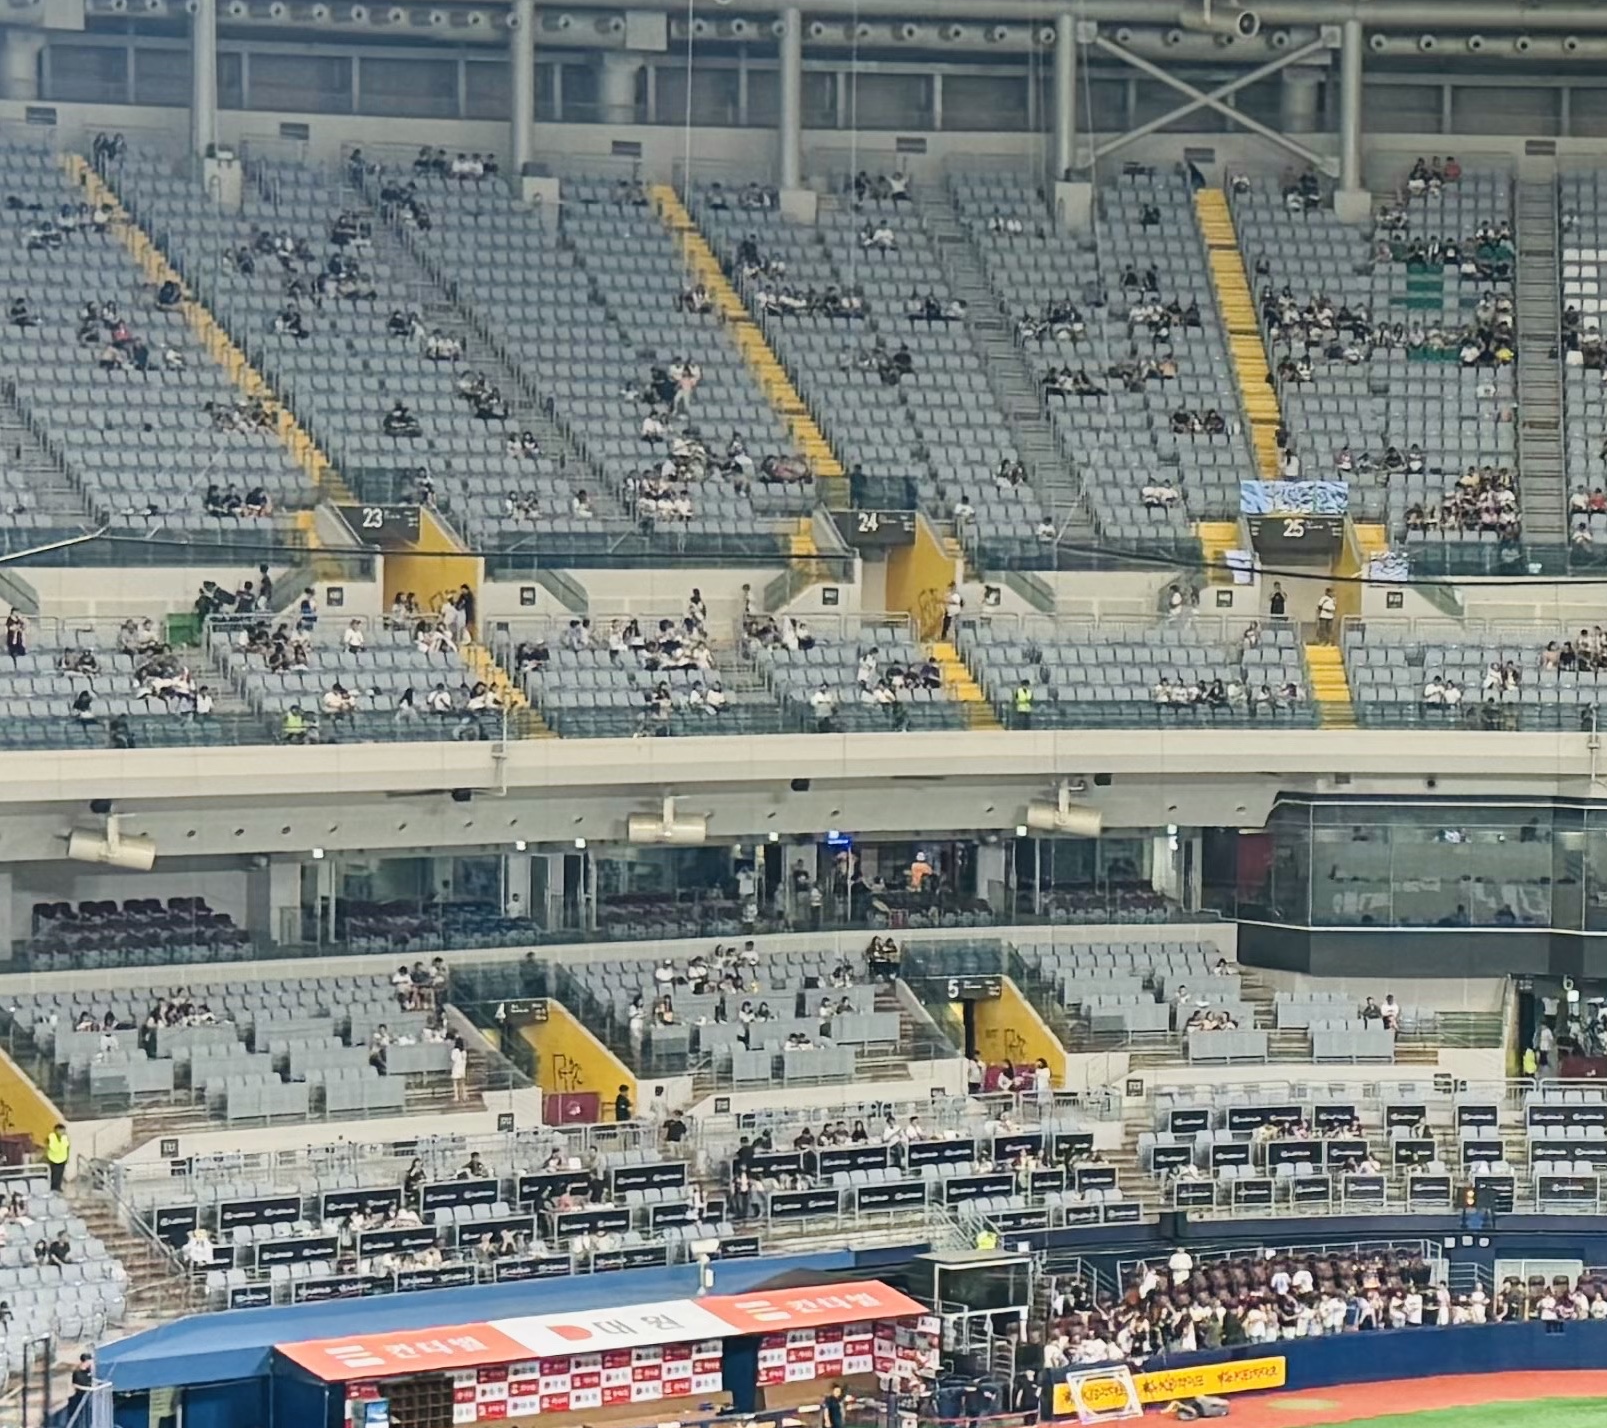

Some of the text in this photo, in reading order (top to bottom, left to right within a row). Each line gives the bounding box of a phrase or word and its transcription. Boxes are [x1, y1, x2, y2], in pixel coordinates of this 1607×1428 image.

[363, 507, 383, 528] 23
[858, 512, 879, 532] 24
[1283, 518, 1305, 537] 25
[947, 979, 959, 998] 5
[495, 1003, 507, 1022] 4
